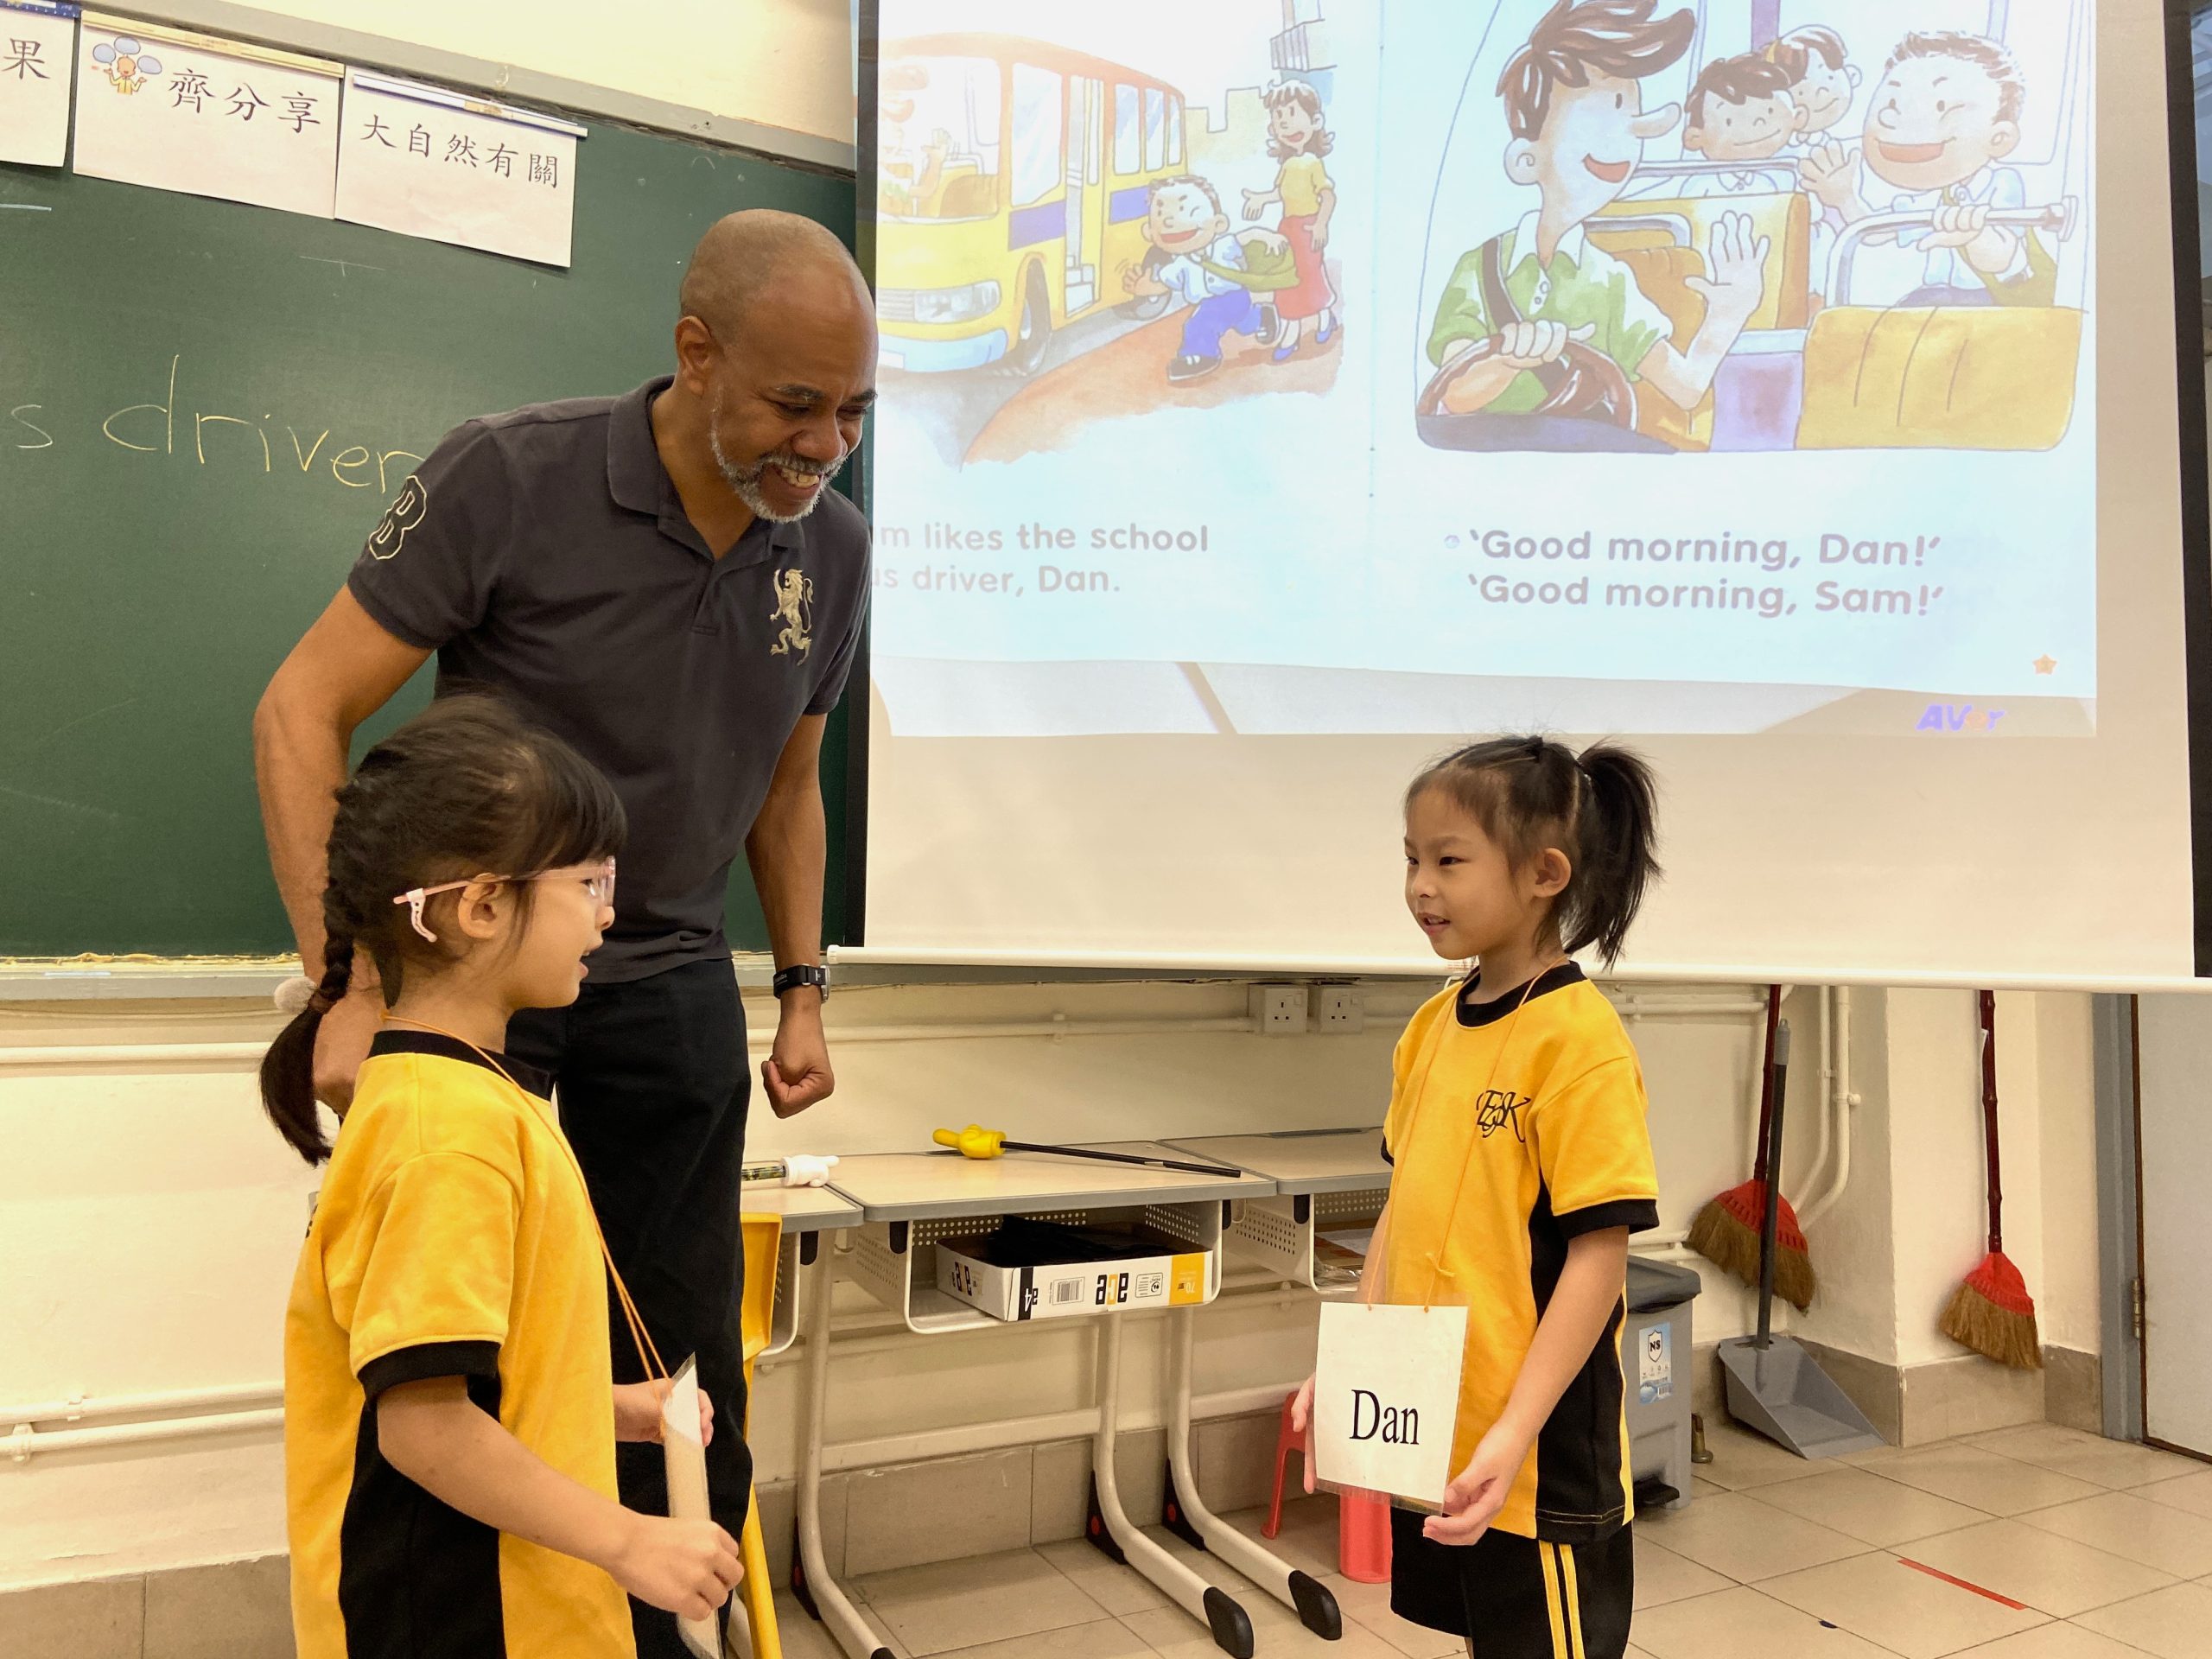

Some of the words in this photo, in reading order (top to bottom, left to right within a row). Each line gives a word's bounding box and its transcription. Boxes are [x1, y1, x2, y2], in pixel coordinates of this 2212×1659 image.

[2, 37, 51, 80] 果
[167, 67, 321, 134] 齊分享
[359, 113, 559, 189] 大自然有關
[10, 404, 54, 448] s
[102, 354, 426, 494] driver
[924, 522, 1004, 551] likes
[1015, 523, 1077, 550] the
[1090, 523, 1209, 553] school
[1608, 531, 1802, 572] morning,
[912, 564, 1025, 598] driver,
[1038, 564, 1121, 594] Dan.
[1605, 577, 1799, 619] morning,
[1095, 1272, 1129, 1306] ace
[1649, 1339, 1661, 1352] NS
[1349, 1389, 1420, 1446] Dan
